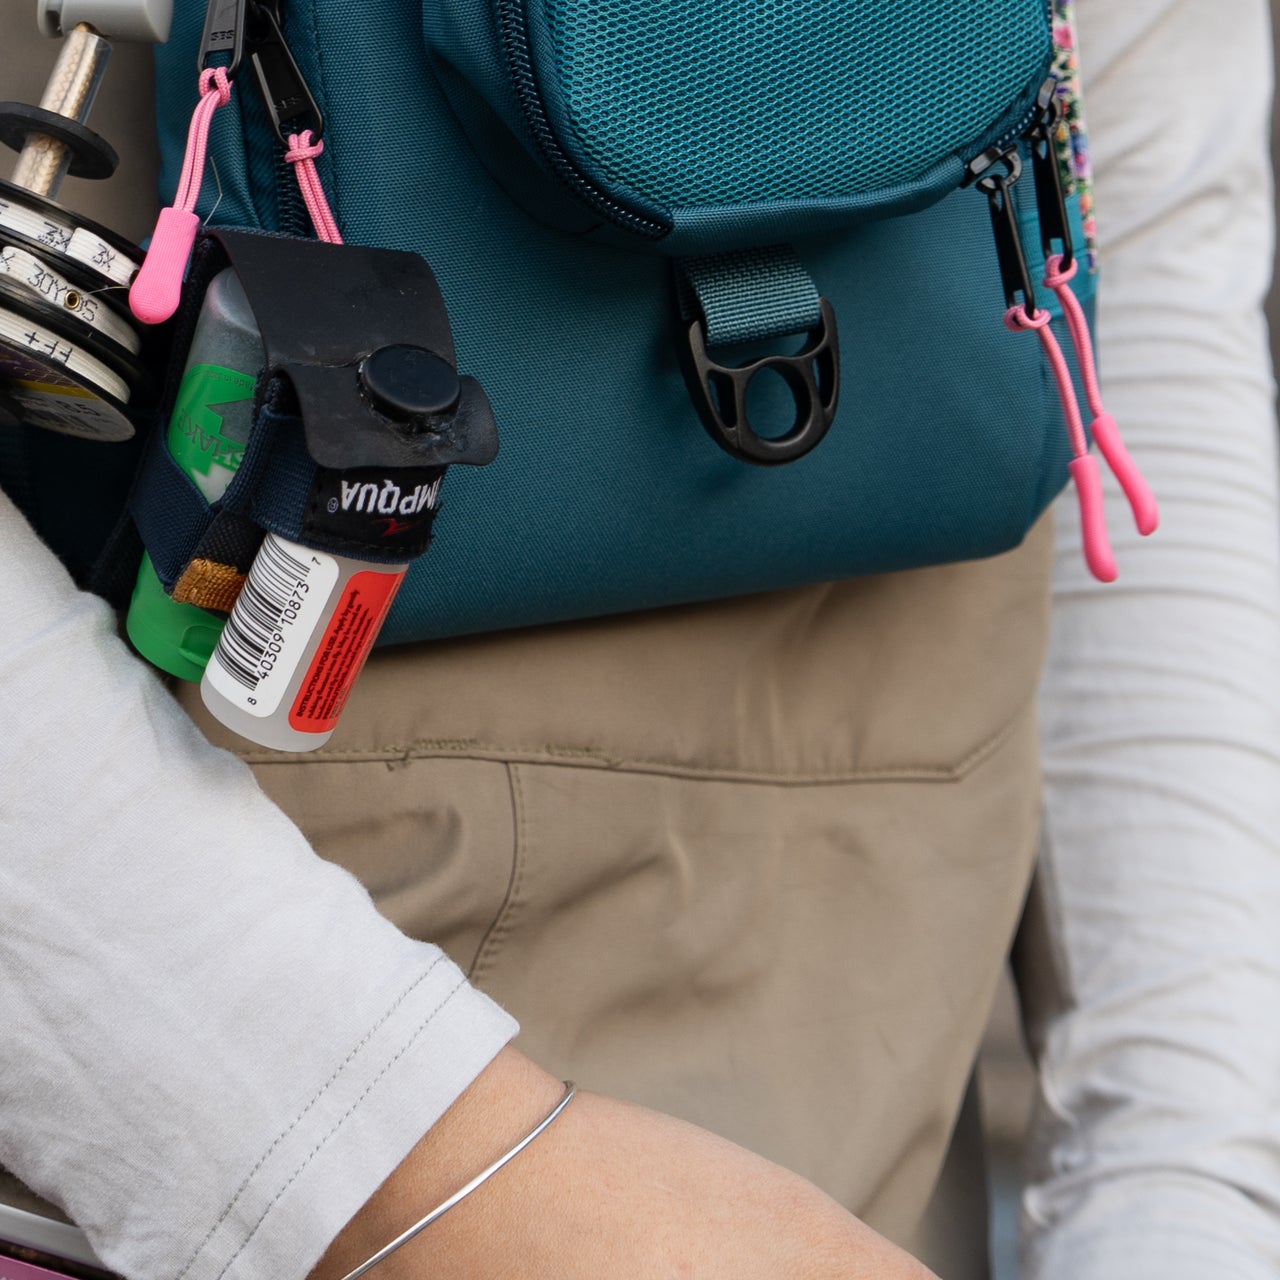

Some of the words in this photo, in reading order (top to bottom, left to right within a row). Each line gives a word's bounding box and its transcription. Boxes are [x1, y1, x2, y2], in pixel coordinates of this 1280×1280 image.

[246, 696, 258, 706] 8
[257, 633, 283, 680] 40309
[281, 581, 310, 625] 10873
[312, 556, 323, 566] 7
[295, 664, 324, 717] INSTRUCTIONS
[318, 650, 330, 666] FOR
